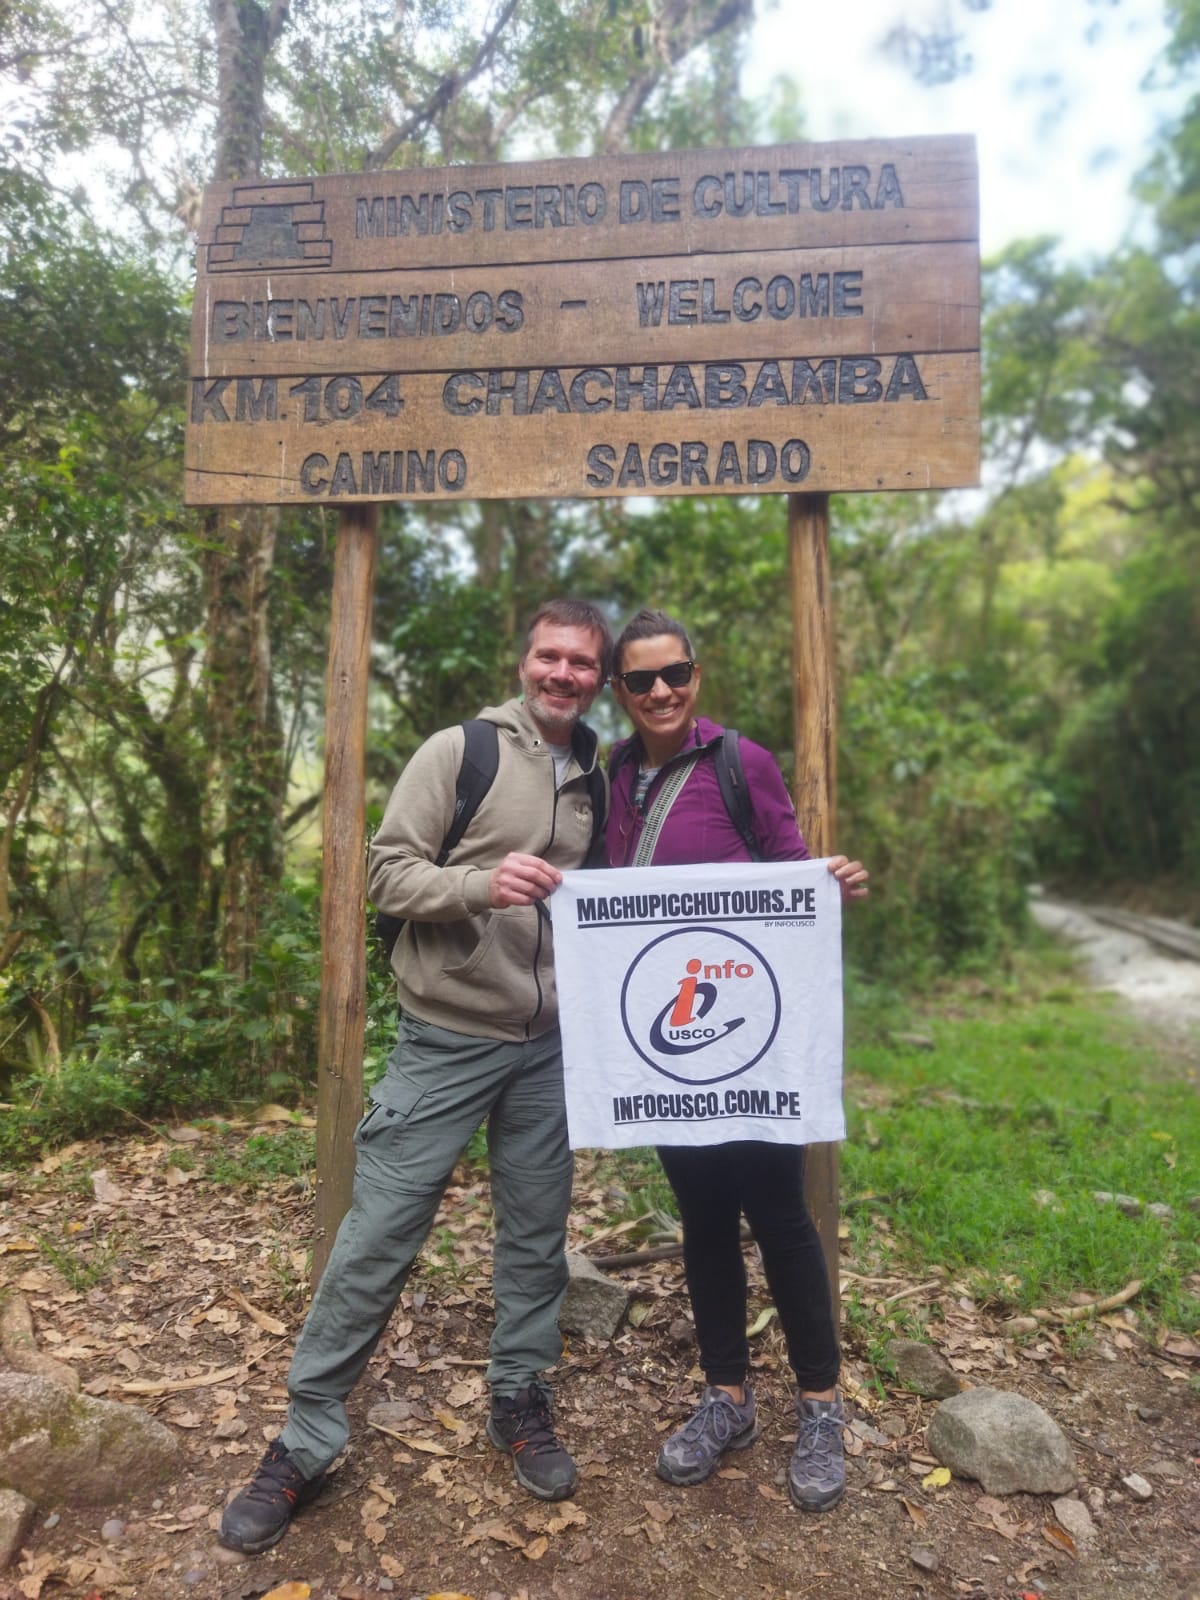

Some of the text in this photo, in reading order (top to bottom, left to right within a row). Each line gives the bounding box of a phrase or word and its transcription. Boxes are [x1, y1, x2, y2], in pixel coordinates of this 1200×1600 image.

[355, 163, 905, 240] MINISTERIO DE CULTURA
[212, 290, 525, 344] BIENVENIDOS
[636, 270, 864, 328] WELCOME
[443, 354, 928, 415] CHACHABAMBA
[301, 438, 811, 496] CAMINO SAGRADO
[576, 888, 816, 922] MACHUPICCHUTOURS.PE
[612, 1089, 801, 1122] INFOCUSCO.COM.PE
